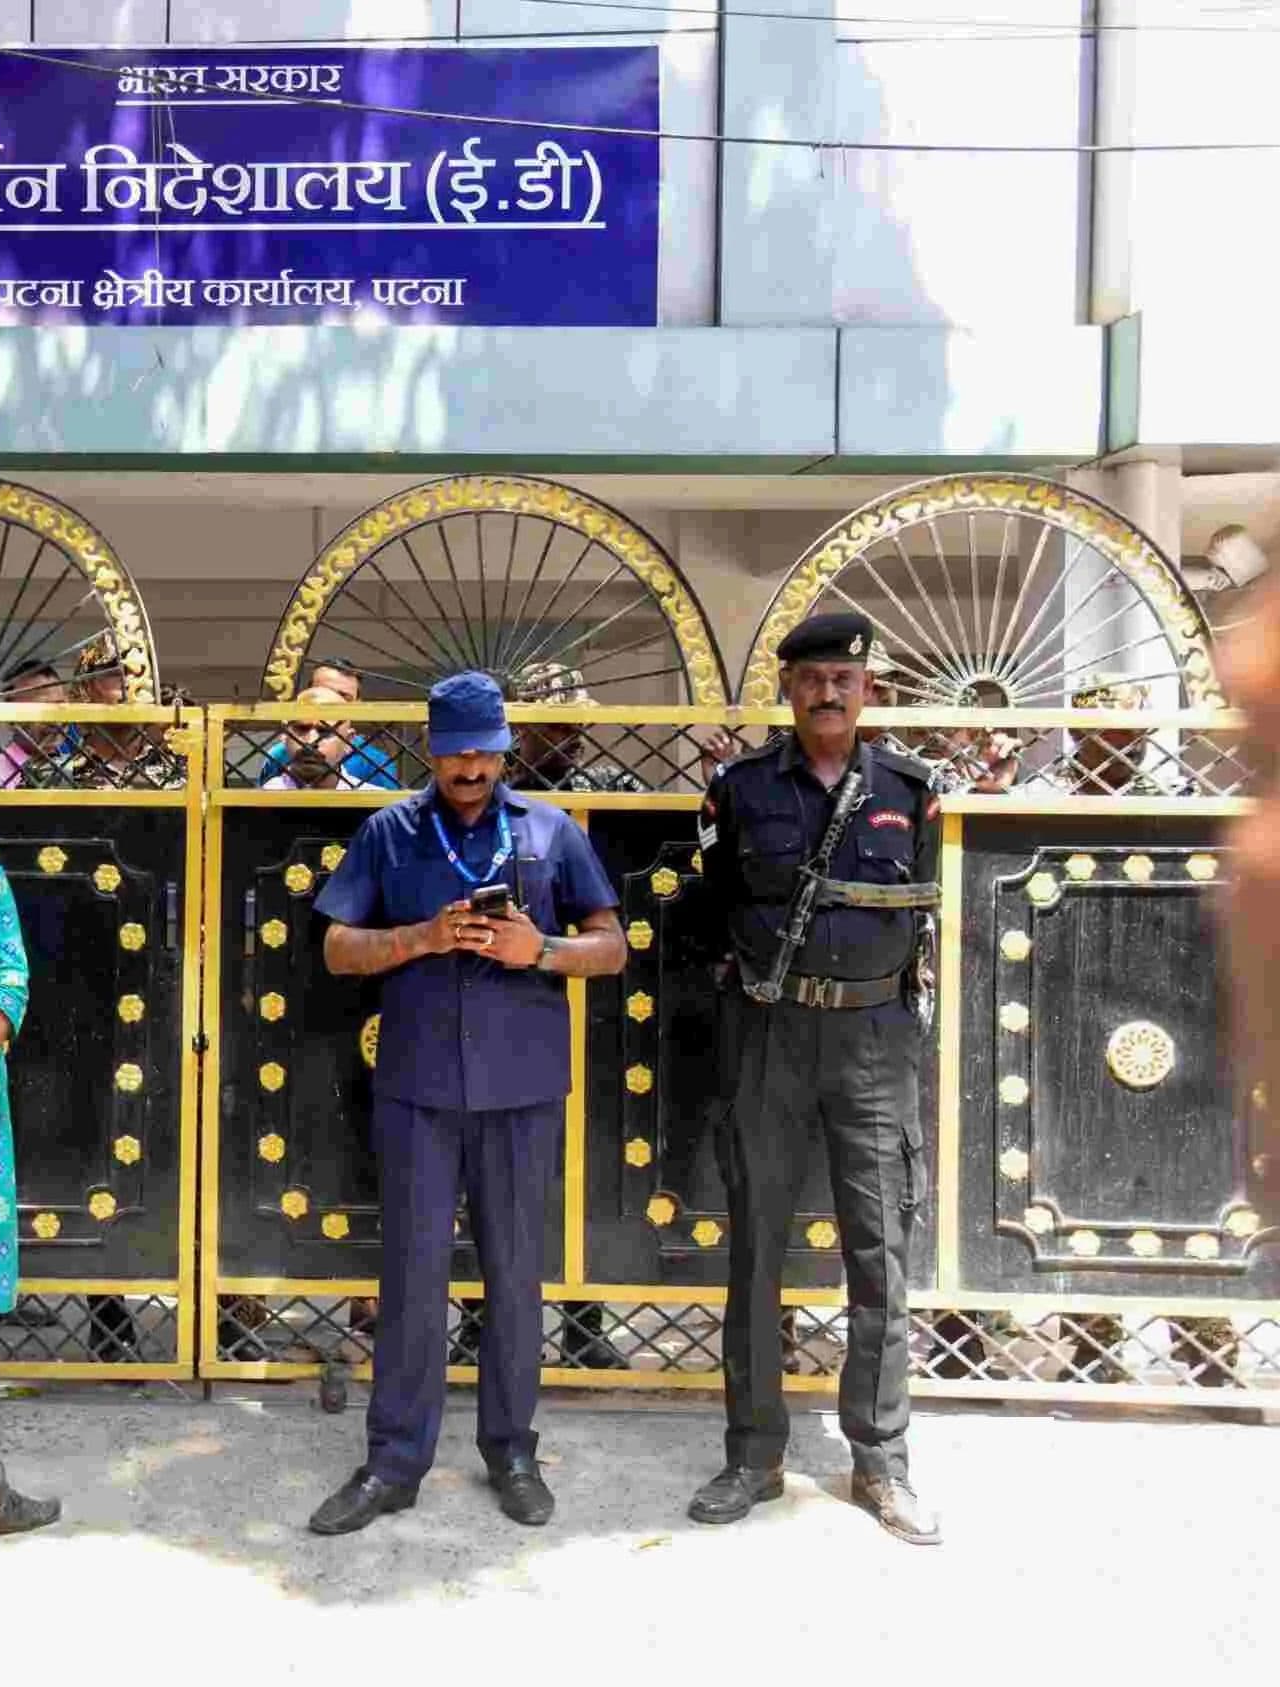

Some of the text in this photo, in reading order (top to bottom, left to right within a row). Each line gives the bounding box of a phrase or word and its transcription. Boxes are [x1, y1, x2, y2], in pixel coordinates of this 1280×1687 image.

[117, 65, 345, 94] भारत सरकार
[79, 143, 412, 216] निदेशालय
[425, 137, 603, 225] (ई.डी)
[92, 269, 196, 310] क्षेत्रीय
[201, 268, 362, 312] कार्यालय,
[371, 278, 468, 306] पटना
